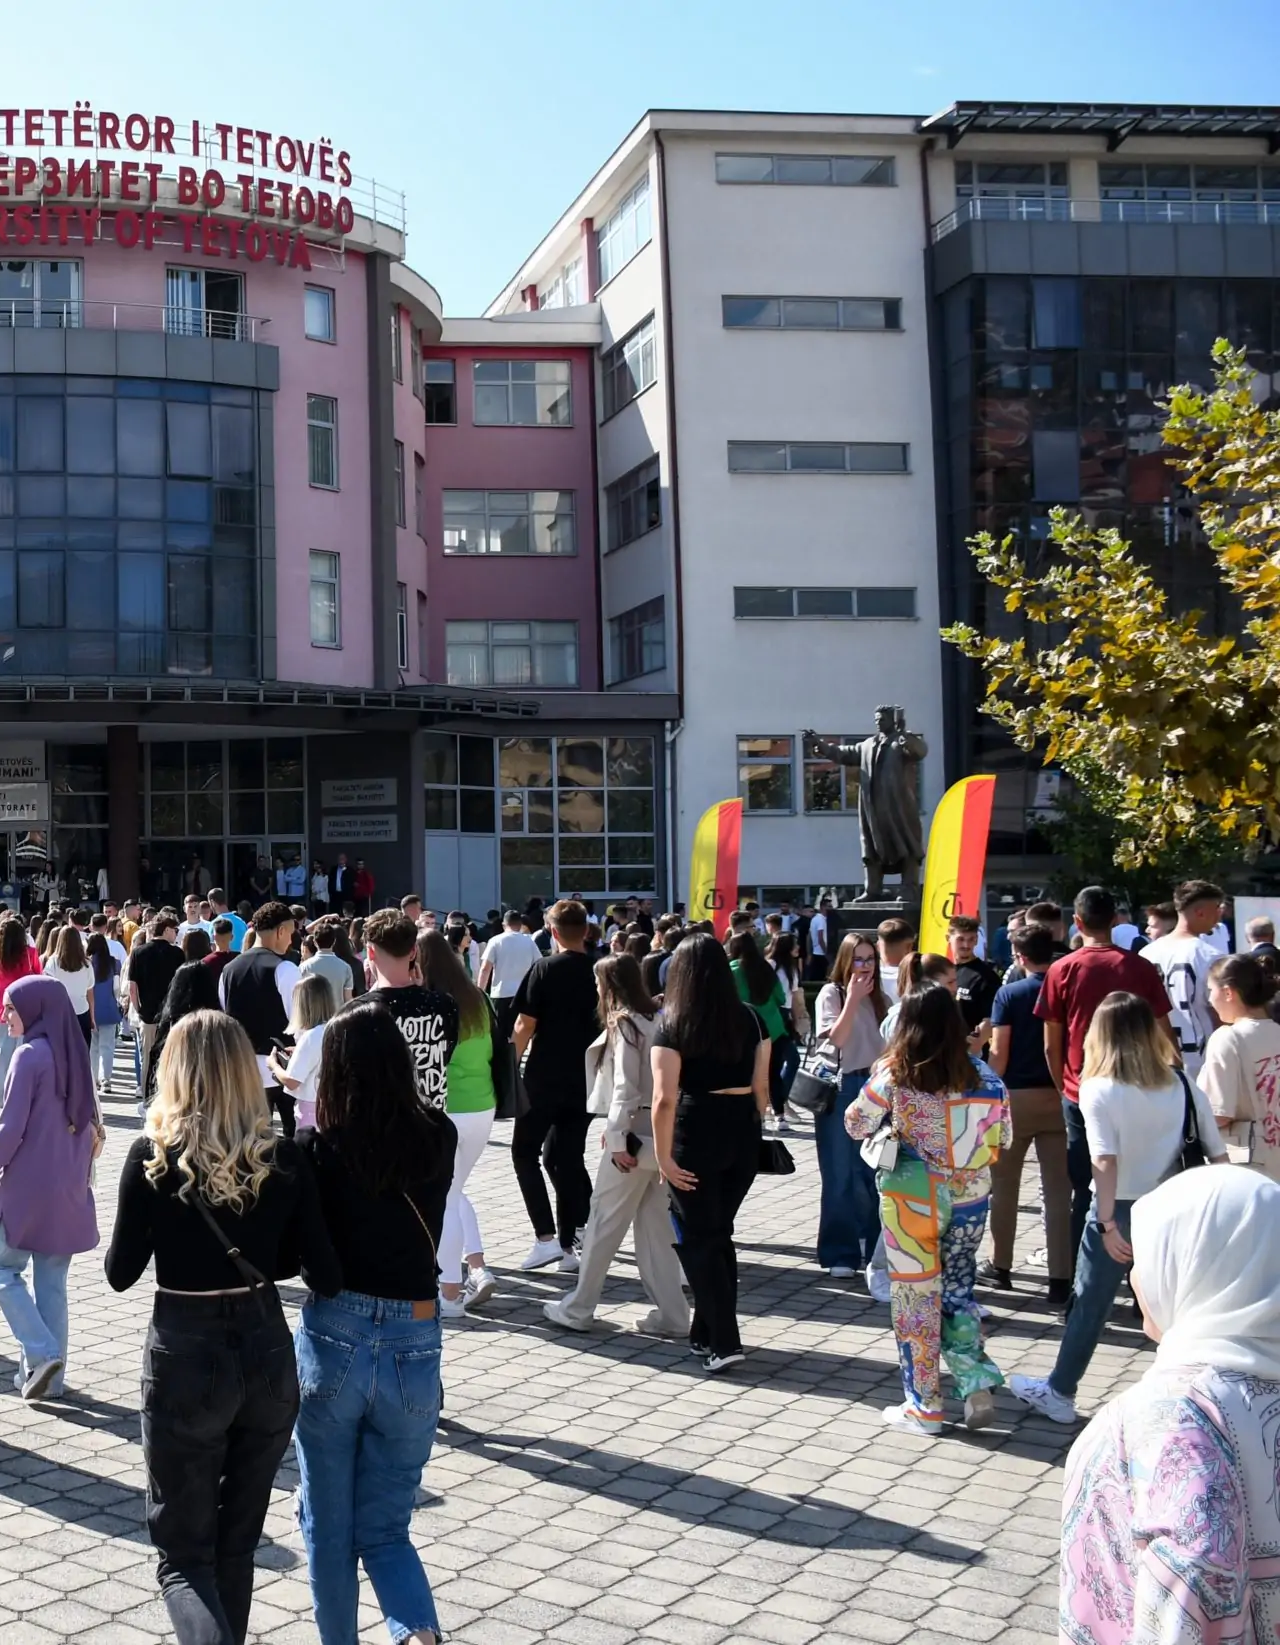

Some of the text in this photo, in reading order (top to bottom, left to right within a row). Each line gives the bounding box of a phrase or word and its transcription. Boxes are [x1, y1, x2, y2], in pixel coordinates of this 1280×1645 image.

[192, 120, 200, 157] I
[215, 123, 353, 188] TETOVËS
[178, 166, 225, 208] ВО
[237, 174, 355, 234] ТЕТОВО
[114, 208, 164, 251] OF
[178, 214, 312, 272] TETOVA
